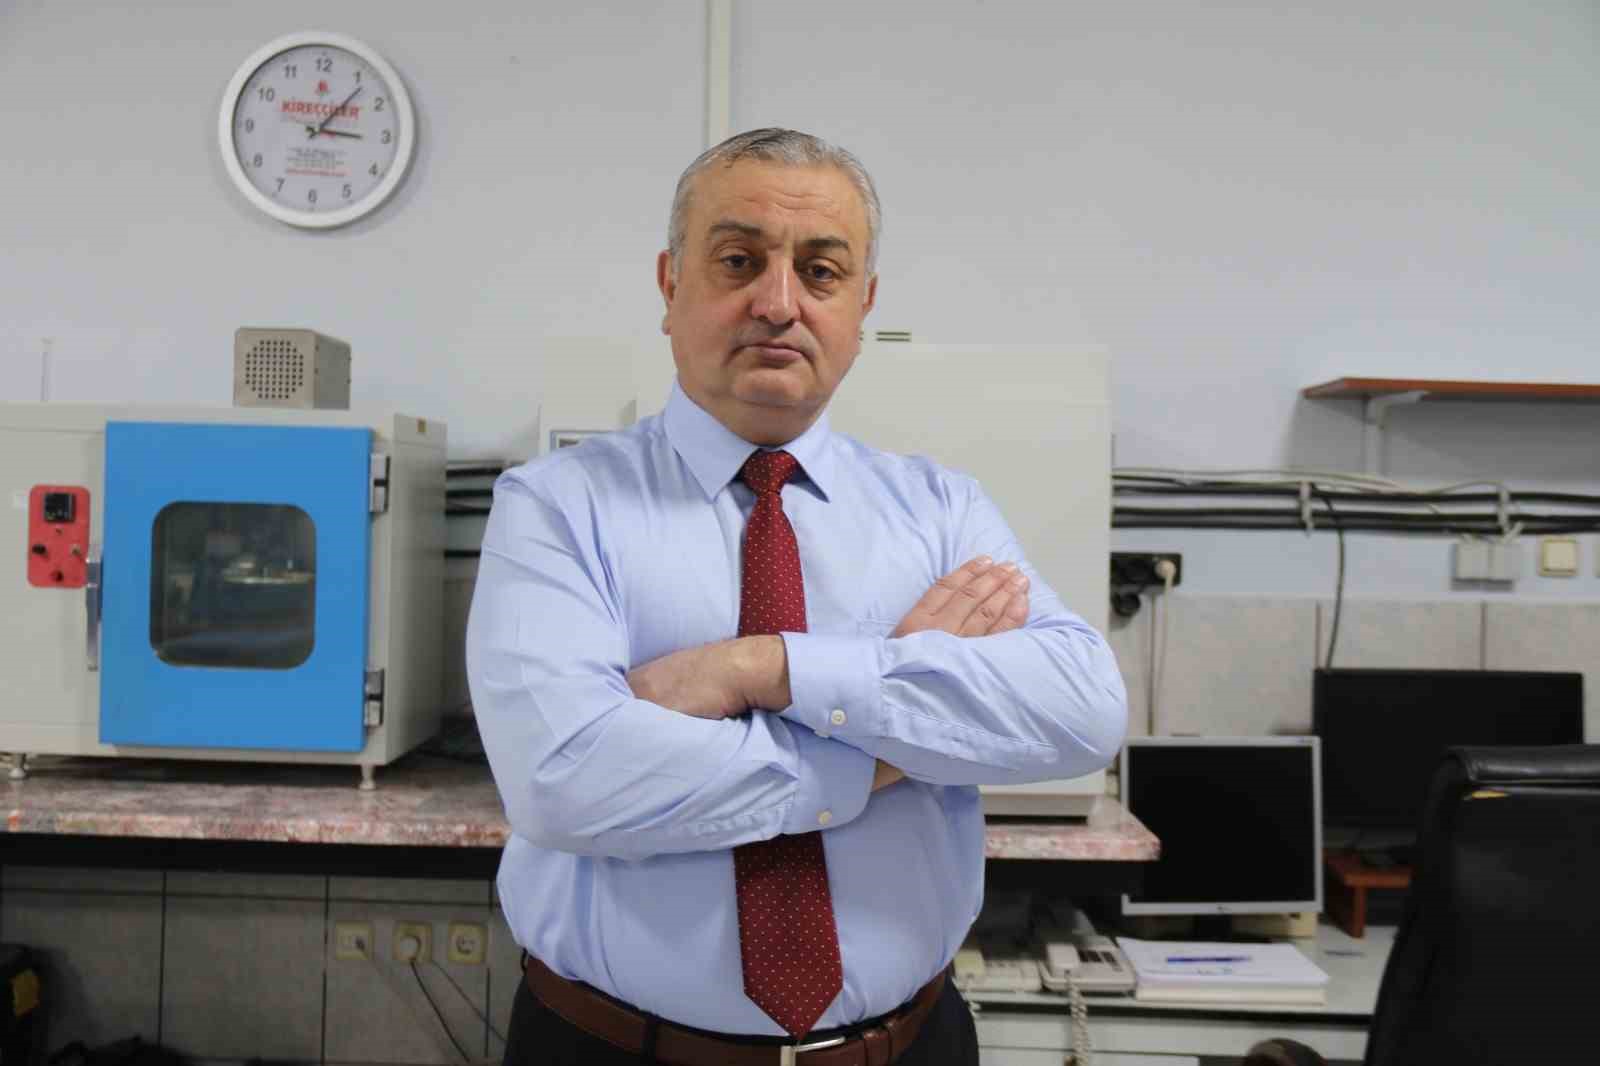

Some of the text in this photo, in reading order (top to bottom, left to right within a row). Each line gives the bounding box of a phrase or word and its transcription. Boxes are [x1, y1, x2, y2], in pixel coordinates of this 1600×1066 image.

[285, 64, 297, 78] 11
[315, 58, 333, 72] 12
[258, 88, 275, 102] 10
[374, 97, 384, 111] 2
[245, 119, 254, 133] 9
[381, 130, 391, 144] 3
[253, 154, 263, 168] 8
[368, 164, 378, 177] 4
[275, 178, 285, 192] 7
[342, 184, 352, 199] 5
[308, 190, 317, 203] 6
